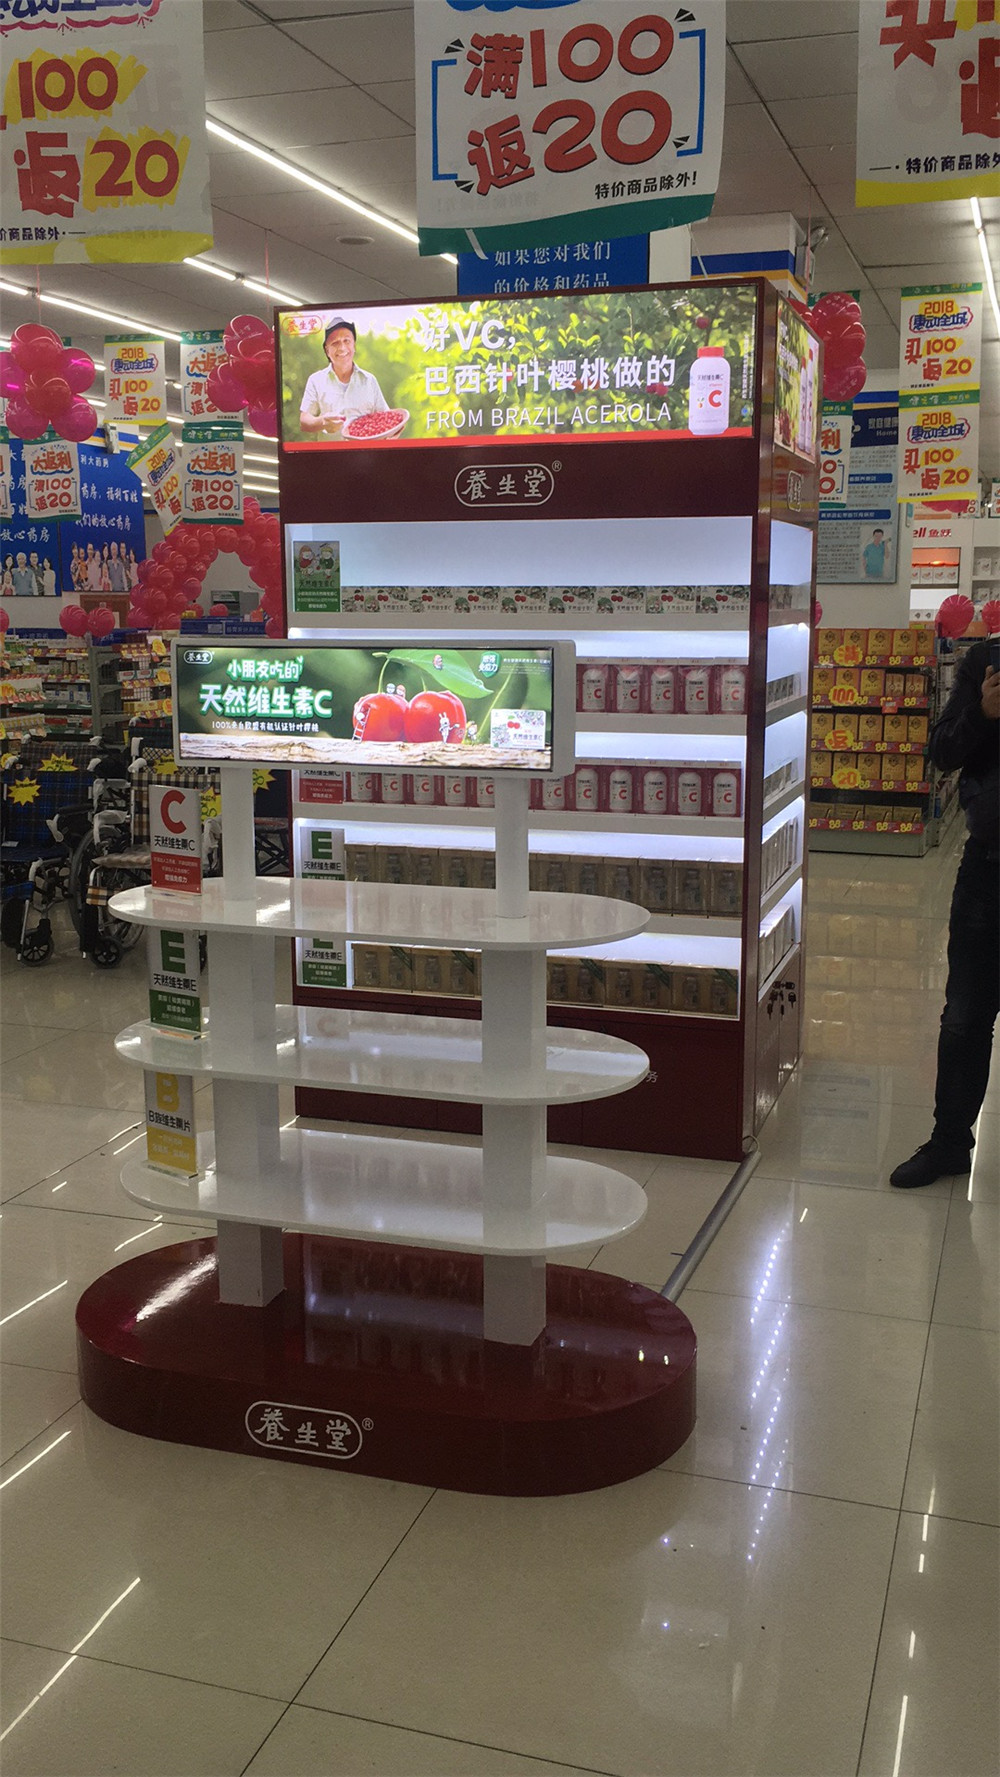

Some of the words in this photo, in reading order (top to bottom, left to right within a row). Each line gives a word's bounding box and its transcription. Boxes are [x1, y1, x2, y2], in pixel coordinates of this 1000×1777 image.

[462, 14, 673, 99] 满100
[467, 90, 673, 197] 返20
[14, 131, 180, 218] 返20
[594, 170, 697, 199] 特价商品除外!
[494, 241, 611, 267] 如果您对我们
[494, 272, 610, 293] 的价格和药品
[924, 301, 954, 315] 2018
[121, 347, 144, 359] 2018
[425, 355, 676, 396] 巴西针叶樱桃做的
[922, 358, 972, 381] 返20
[427, 409, 483, 430] FROM
[491, 406, 564, 427] BRAZIL
[571, 402, 672, 425] ACEROLA
[922, 412, 952, 426] 2018
[33, 451, 72, 471] 大返利
[191, 451, 236, 471] 大返利
[35, 477, 72, 493] 满100
[192, 479, 234, 493] 满100
[462, 468, 546, 501] 養生堂
[921, 468, 970, 490] 返20
[36, 492, 72, 511] 返20
[192, 494, 234, 513] 返20
[226, 656, 304, 682] 小朋友吃的
[199, 683, 333, 719] 天然维生素C
[160, 789, 187, 834] C
[154, 835, 195, 851] 天然维生素C
[311, 830, 333, 860] E
[304, 861, 342, 871] 天然维生素E
[160, 930, 186, 974] E
[305, 950, 342, 961] 天然维生素E
[153, 973, 197, 992] 天然维生素E
[156, 1072, 180, 1112] B
[254, 1407, 352, 1453] 養生堂
